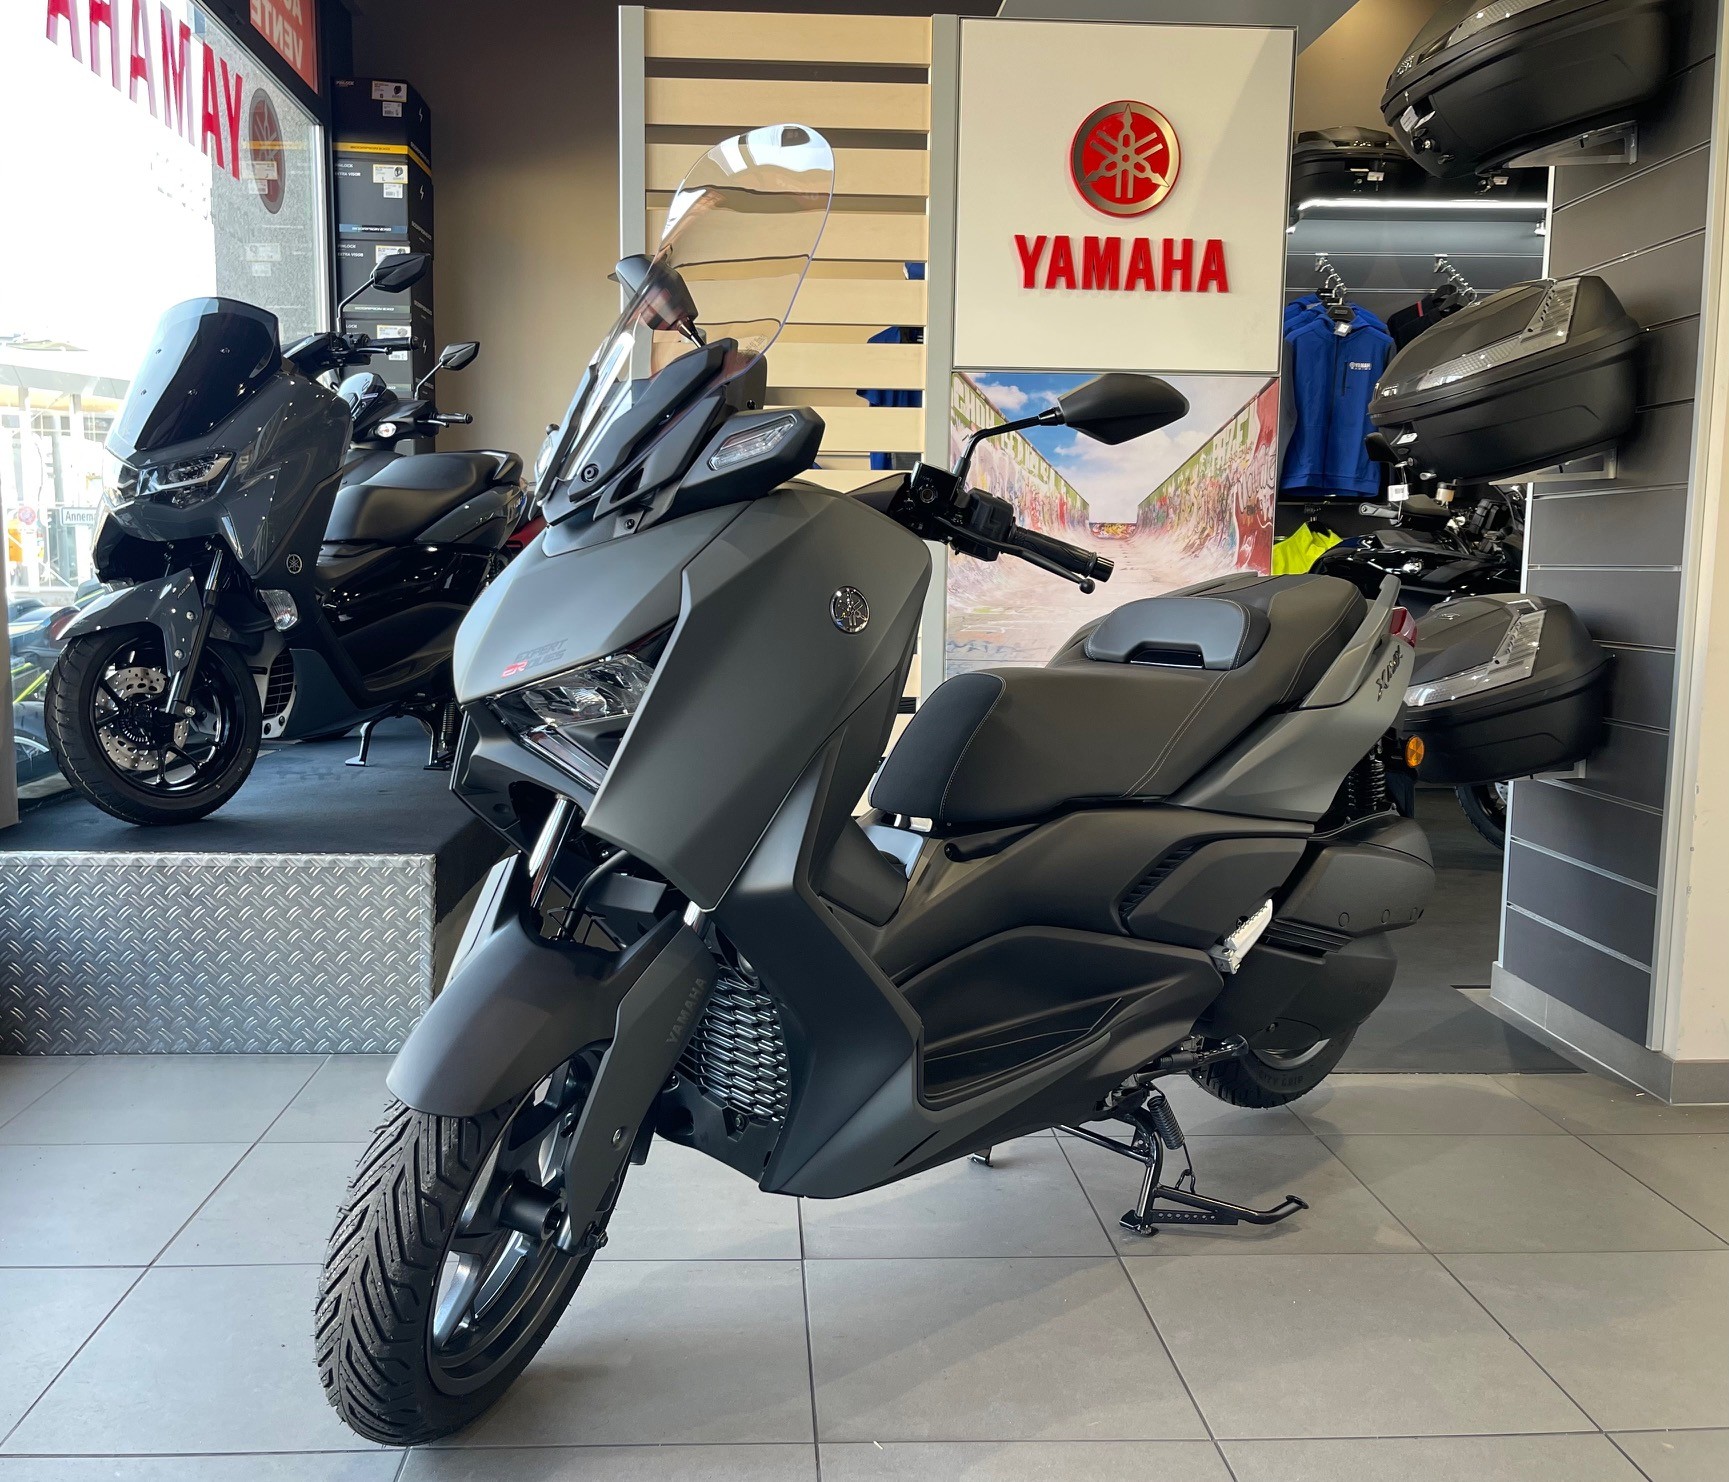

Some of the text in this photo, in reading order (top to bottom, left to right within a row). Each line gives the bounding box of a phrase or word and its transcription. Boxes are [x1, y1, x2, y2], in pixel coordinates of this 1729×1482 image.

[1014, 234, 1229, 293] YAMAHA
[65, 510, 95, 522] Annem
[665, 977, 707, 1043] YAMAHA
